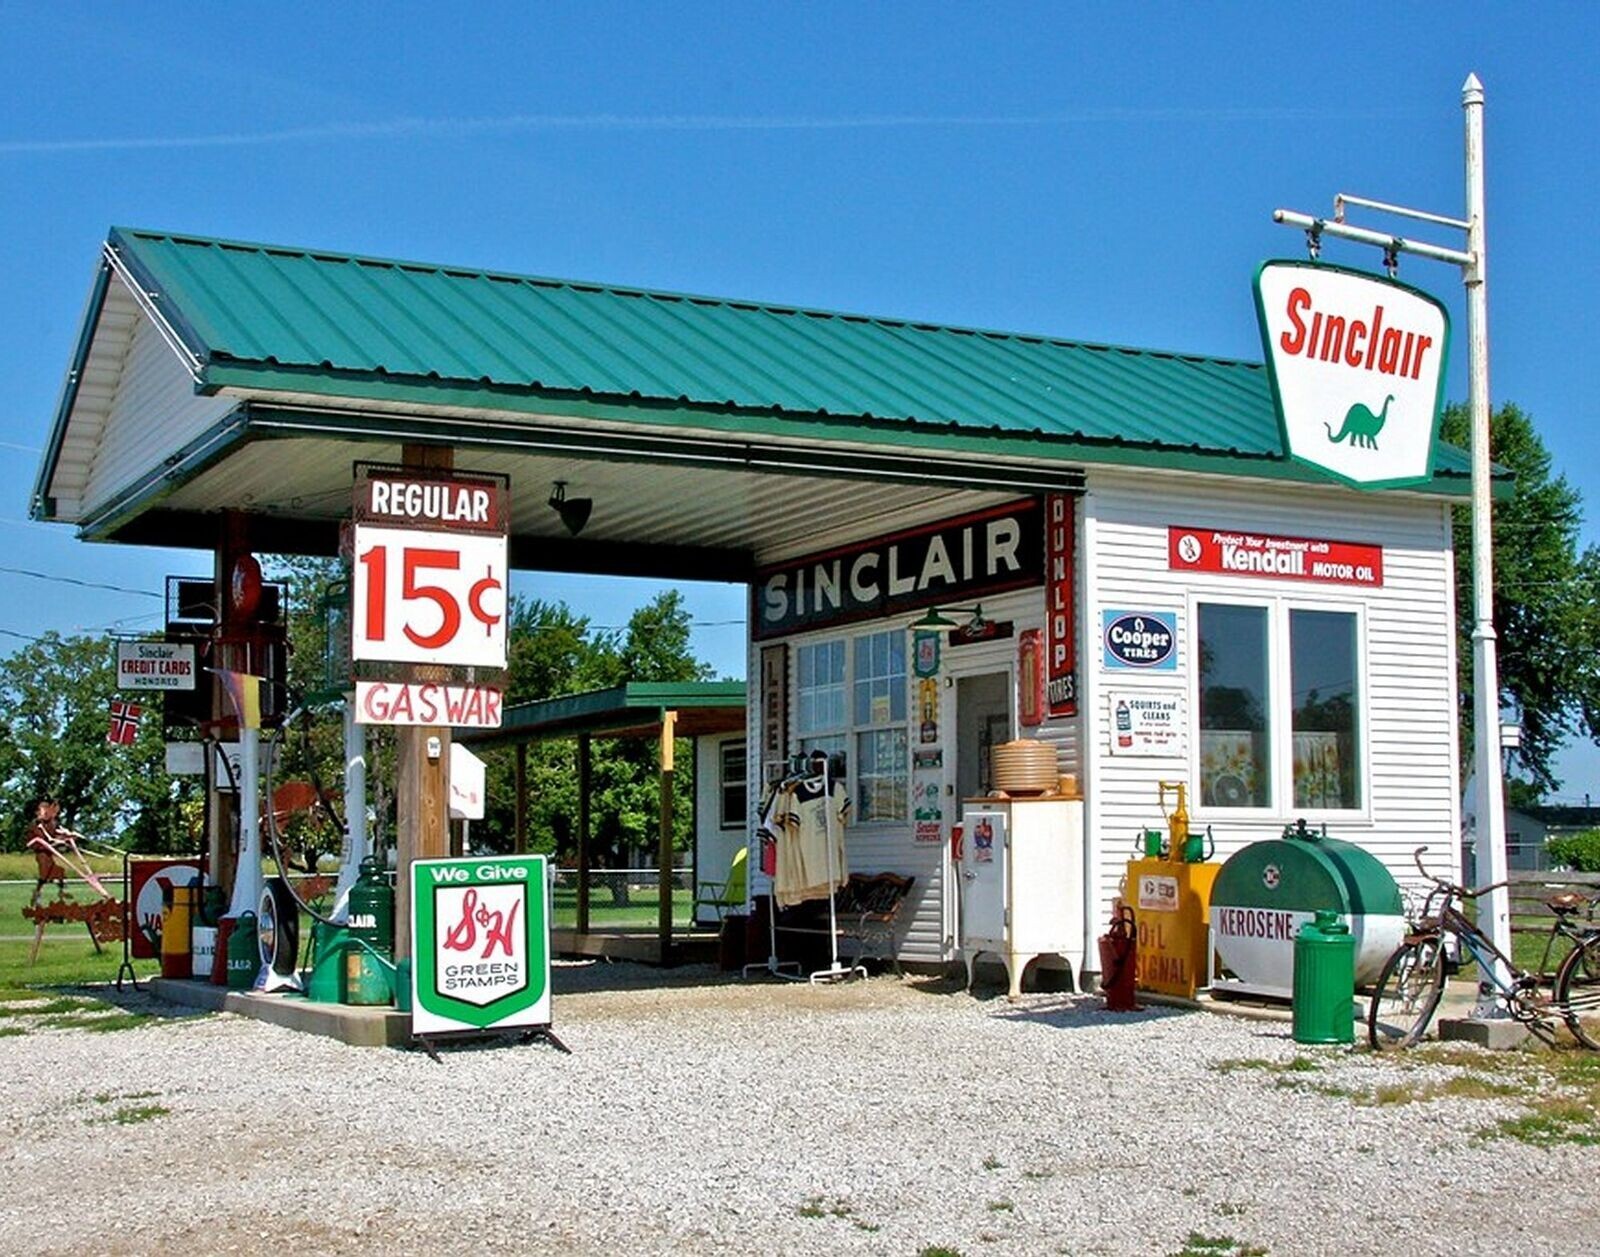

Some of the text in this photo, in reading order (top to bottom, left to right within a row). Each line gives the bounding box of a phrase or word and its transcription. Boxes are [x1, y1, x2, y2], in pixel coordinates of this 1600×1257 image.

[1280, 287, 1432, 380] Sinclair
[371, 480, 489, 522] REGULAR
[1212, 533, 1329, 554] Protect Your Investment with
[765, 517, 1021, 622] SINCLAIR
[1222, 545, 1374, 581] Kendall MOTOR OIL
[1053, 498, 1066, 669] DUNLOP
[1111, 626, 1169, 648] Cooper
[138, 646, 174, 658] Sinclair
[1122, 647, 1158, 659] TIRES
[121, 660, 191, 675] CREDIT CARDS
[134, 677, 179, 686] HONORED
[430, 864, 528, 882] We Give
[1219, 908, 1294, 940] KEROSENE
[445, 962, 518, 977] GREEN
[445, 974, 519, 990] STAMPS
